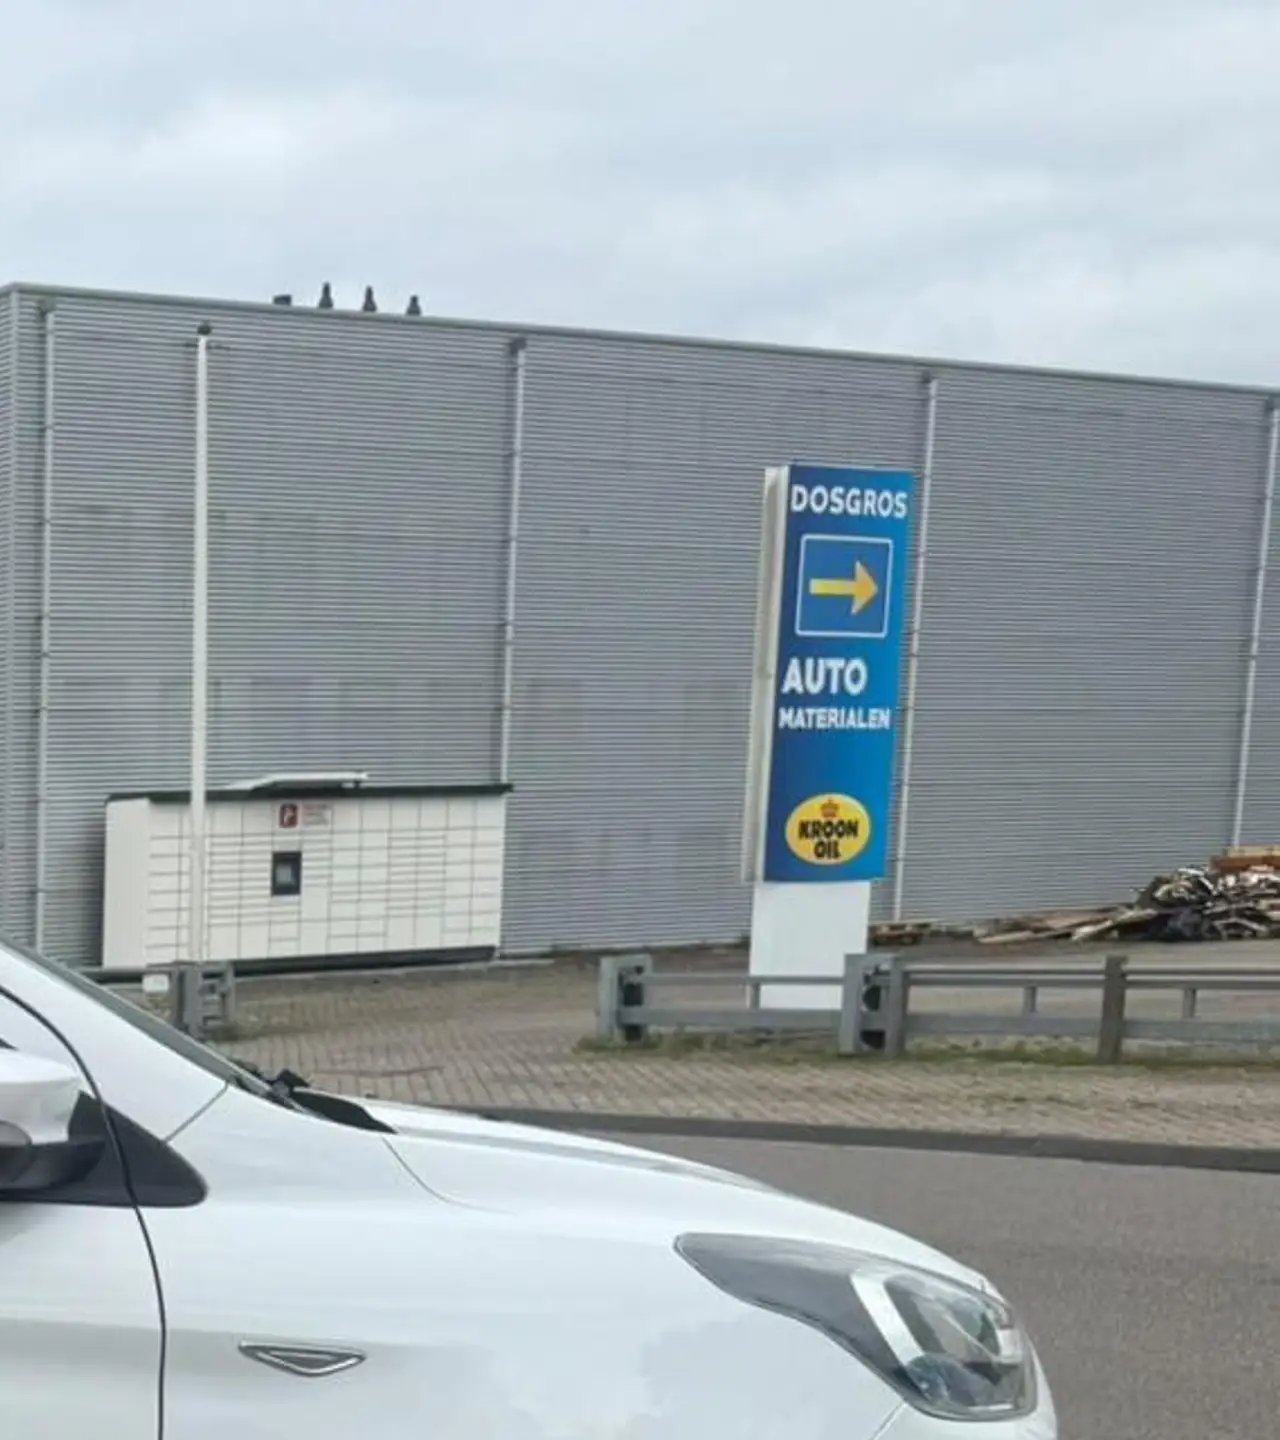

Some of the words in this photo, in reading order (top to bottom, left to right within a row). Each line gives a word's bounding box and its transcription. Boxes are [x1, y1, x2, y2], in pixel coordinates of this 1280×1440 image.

[790, 485, 908, 519] DOSGROS
[781, 657, 868, 696] AUTO
[778, 707, 892, 730] MATERIALEN
[798, 820, 859, 838] KROON
[814, 840, 841, 859] OIL
